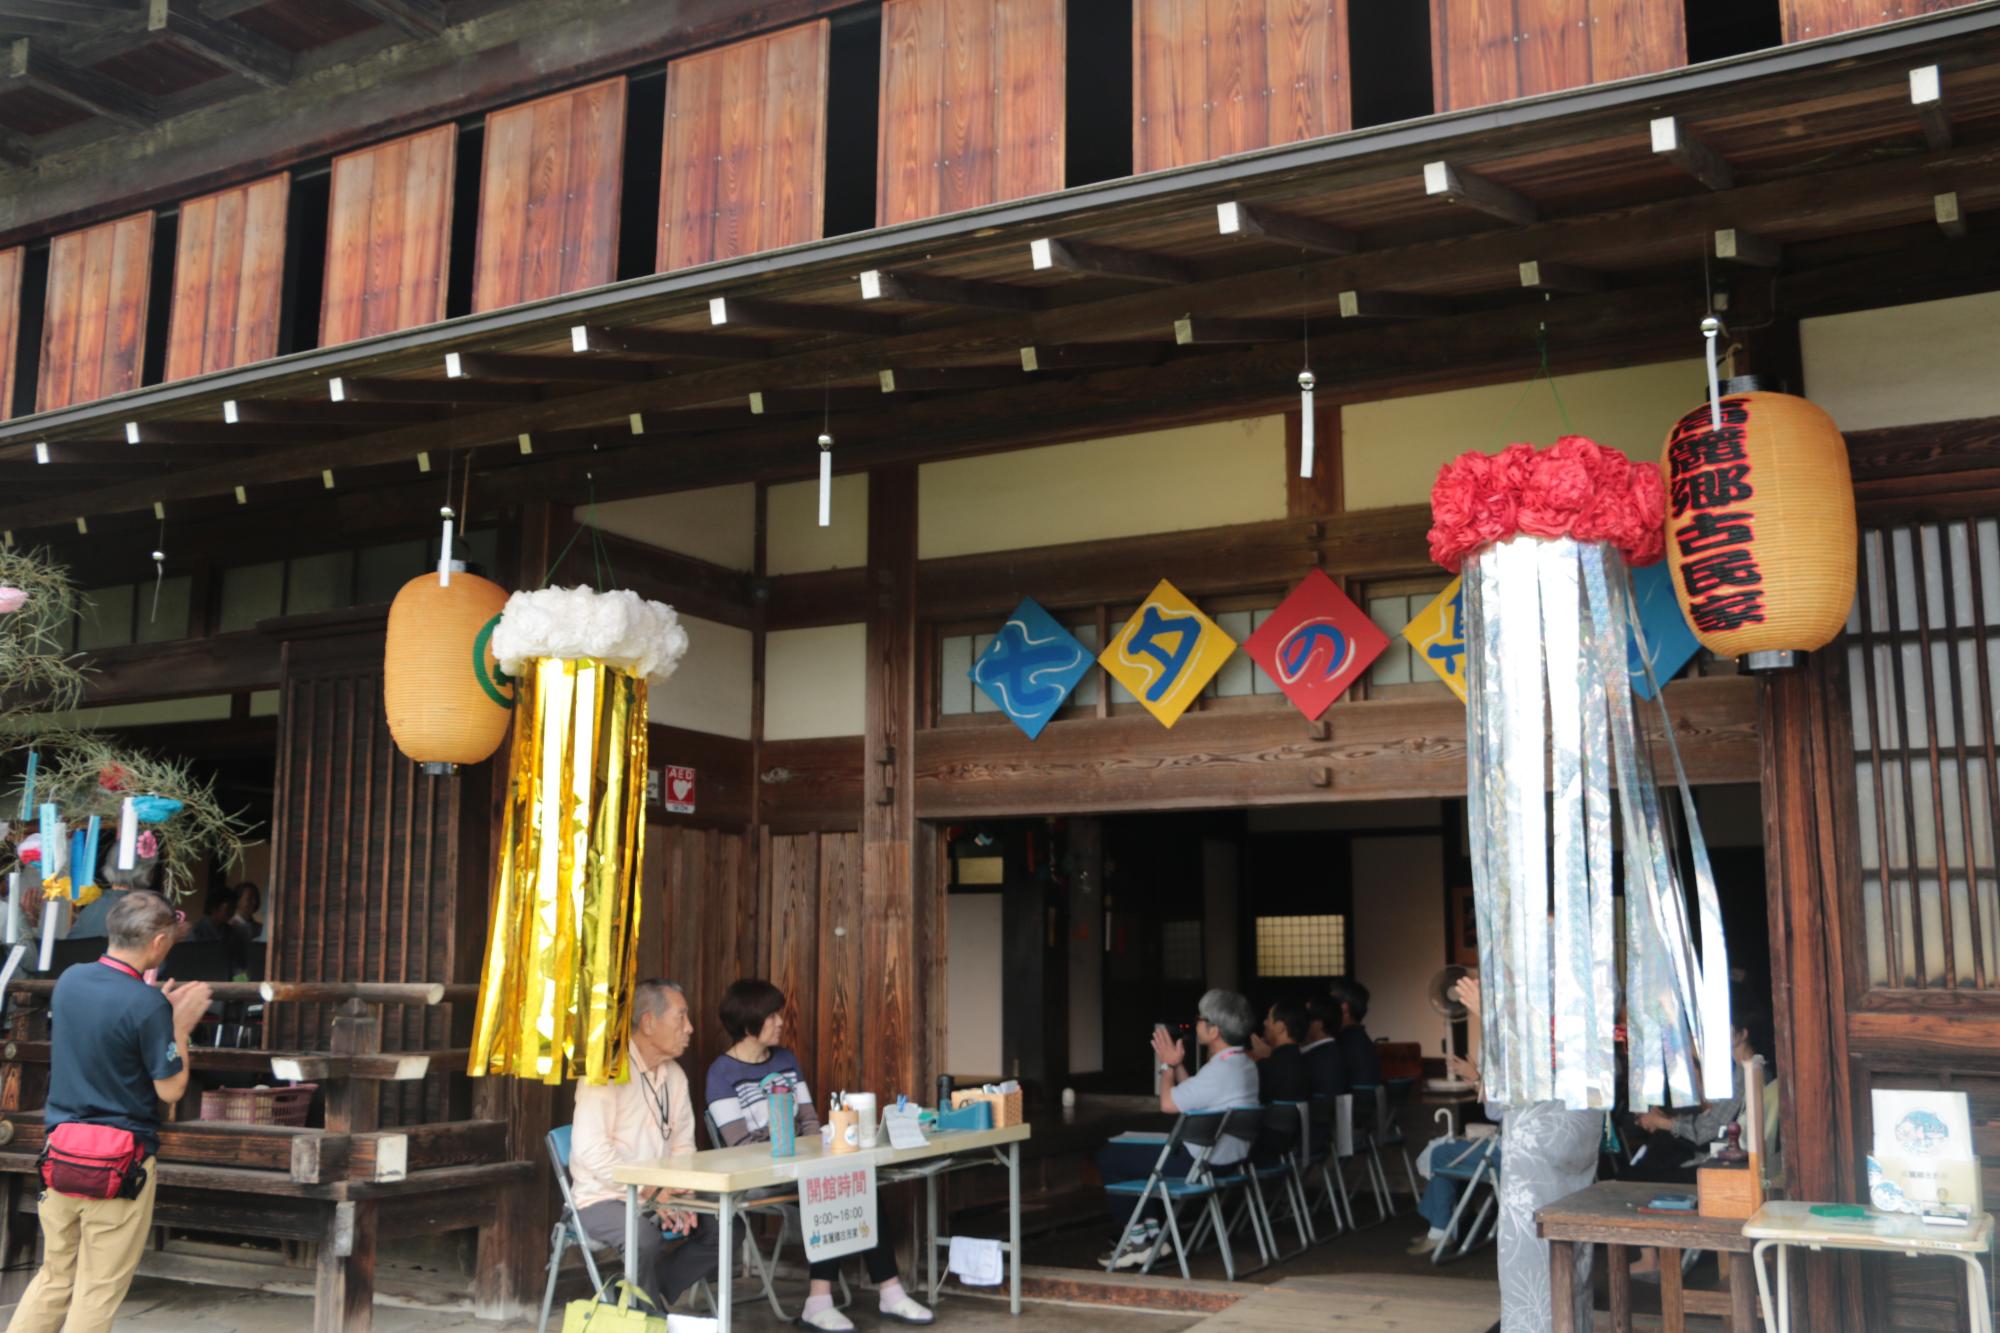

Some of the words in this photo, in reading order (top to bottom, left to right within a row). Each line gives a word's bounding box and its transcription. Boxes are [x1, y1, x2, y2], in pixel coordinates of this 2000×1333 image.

[669, 768, 693, 780] AED
[806, 1170, 867, 1205] 開館時間
